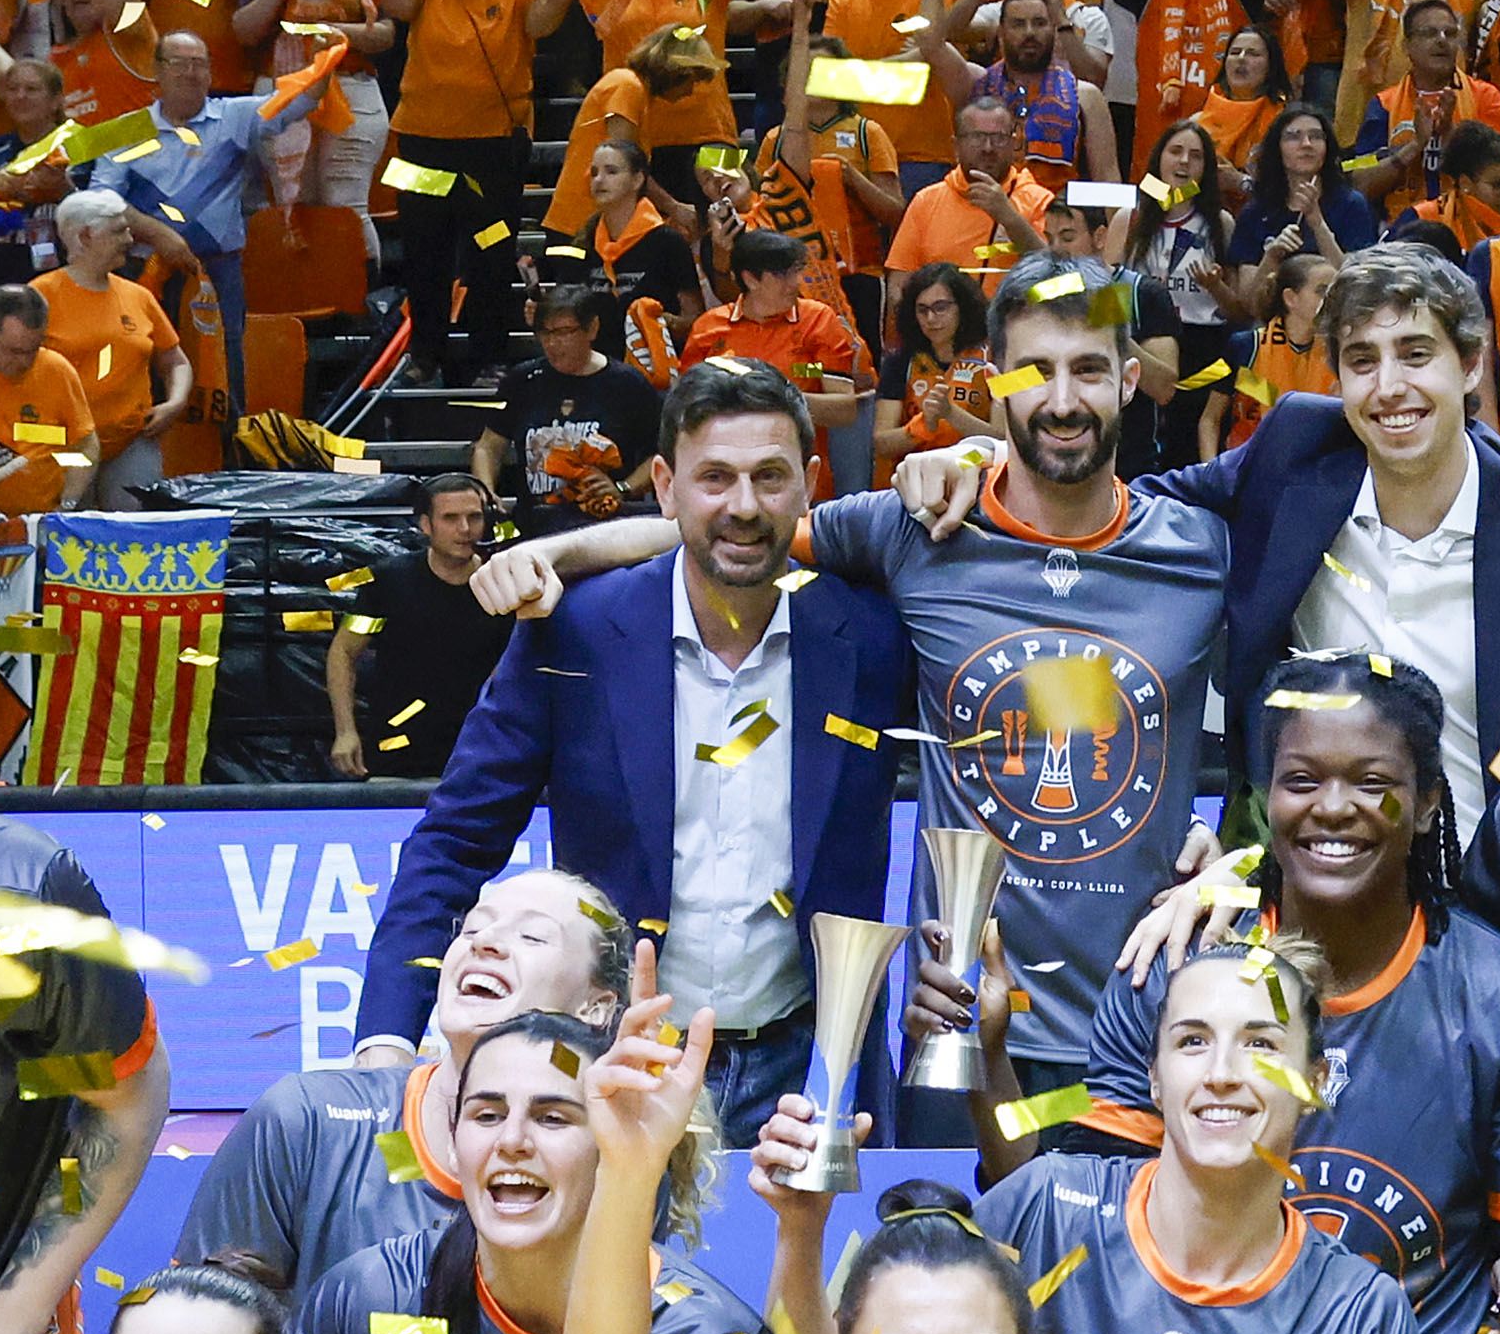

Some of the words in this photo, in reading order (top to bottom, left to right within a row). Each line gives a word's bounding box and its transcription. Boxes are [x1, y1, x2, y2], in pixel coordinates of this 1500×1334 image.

[953, 637, 1162, 732] CAMPIONES
[959, 764, 1155, 859] TRIPLET
[1050, 880, 1083, 893] COPA
